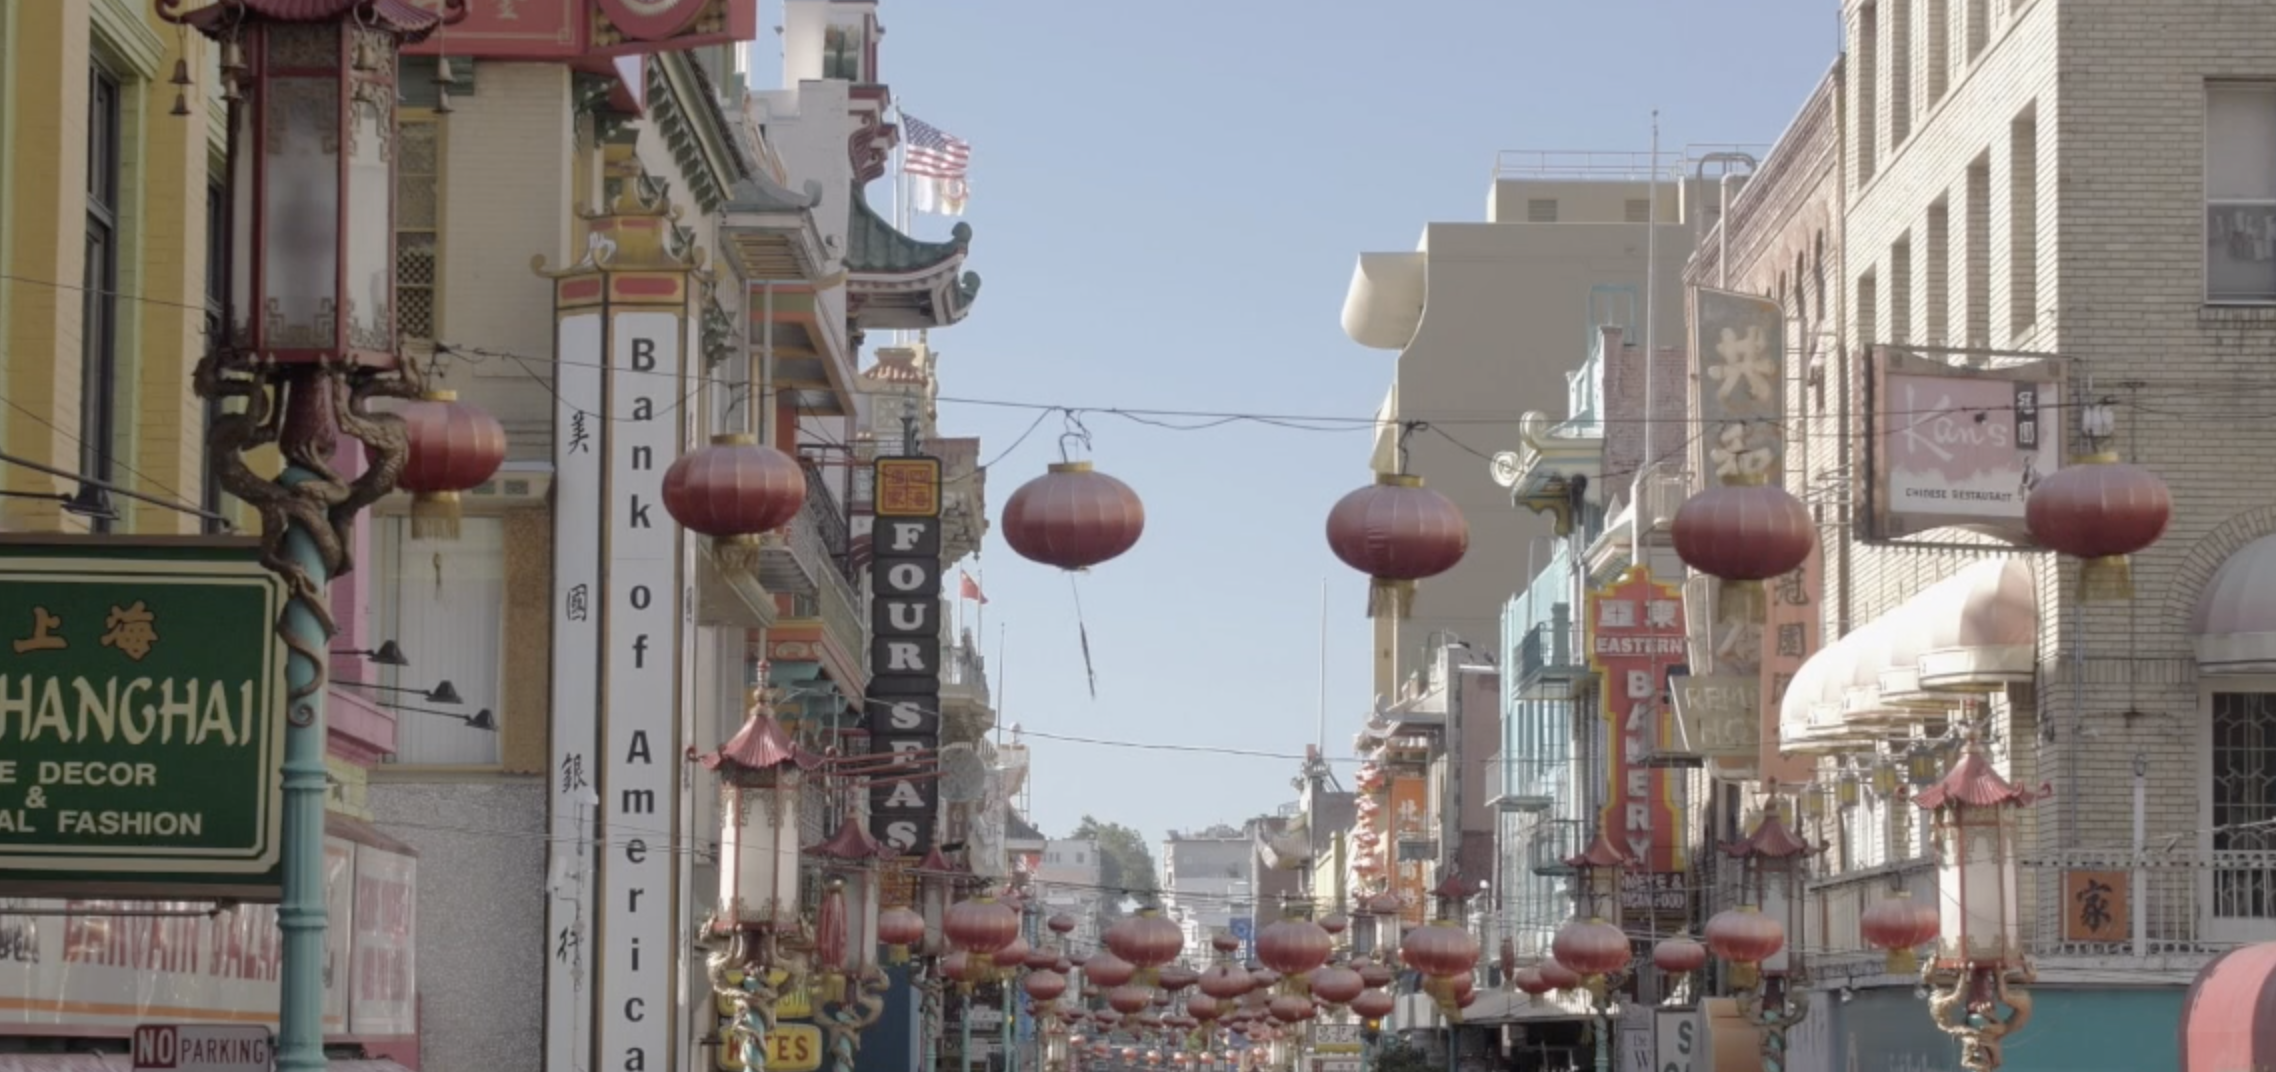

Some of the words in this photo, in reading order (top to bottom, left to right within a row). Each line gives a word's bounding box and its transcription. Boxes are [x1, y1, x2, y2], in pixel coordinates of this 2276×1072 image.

[630, 338, 656, 528] Bank
[1906, 487, 1947, 499] CHINESE
[1952, 489, 2013, 502] RESTAURANT
[629, 584, 651, 668] of
[888, 523, 926, 671] FOUR
[13, 601, 158, 660] 上海
[1596, 637, 1682, 653] EASTERN
[25, 785, 47, 808] &
[39, 762, 156, 786] DECOR
[884, 702, 925, 854] SEAS
[1626, 670, 1655, 864] BAKERY
[58, 811, 202, 835] FASHION
[622, 729, 655, 1071] America
[136, 1029, 174, 1064] NO
[181, 1038, 264, 1064] PARKING
